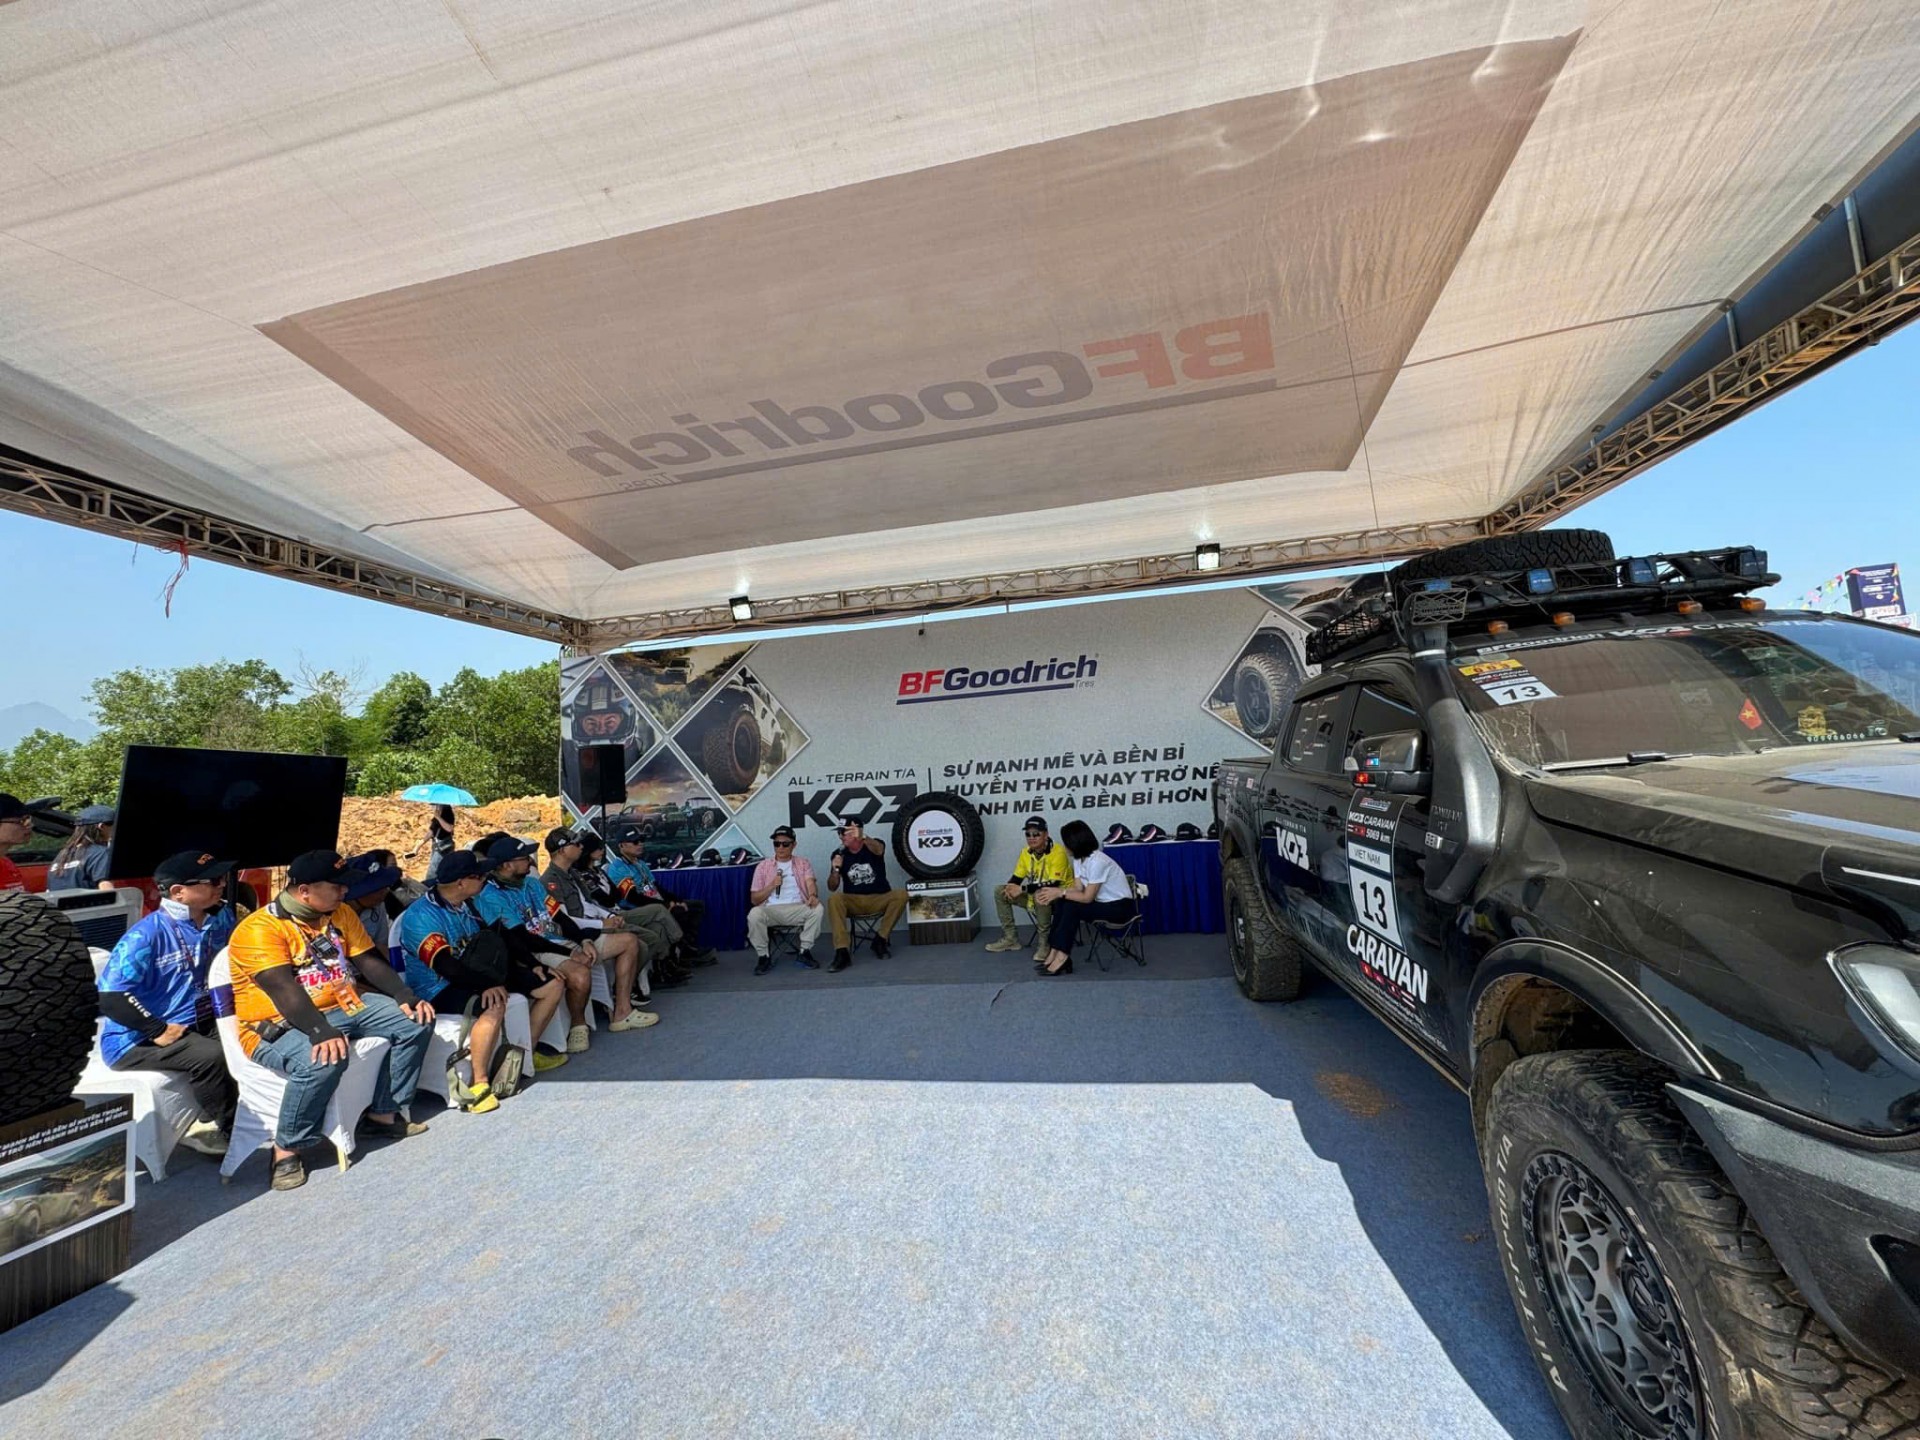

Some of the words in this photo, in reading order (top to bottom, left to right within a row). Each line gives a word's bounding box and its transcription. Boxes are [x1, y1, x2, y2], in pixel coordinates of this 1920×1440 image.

[898, 654, 1098, 696] BFGoodrich
[1502, 685, 1541, 701] 13
[788, 776, 814, 787] ALL
[826, 770, 890, 784] TERRAIN
[893, 768, 916, 779] T/A
[943, 758, 974, 780] SỰ
[975, 757, 1039, 777] MẠNH
[1043, 751, 1075, 770] MẼ
[1080, 747, 1108, 767] VÀ
[1112, 743, 1158, 765] BỀN
[1162, 742, 1185, 761] BỈ
[1022, 774, 1088, 793] THOẠI
[1093, 771, 1137, 787] NAY
[1140, 764, 1189, 783] TRỞ
[1191, 762, 1220, 781] NÊ
[1012, 795, 1045, 814] MẼ
[1049, 794, 1077, 811] VÀ
[1081, 788, 1127, 809] BỀN
[1131, 787, 1154, 806] BỈ
[1158, 786, 1208, 804] HƠN
[1364, 815, 1396, 831] CARAVAN
[918, 836, 954, 849] KO3
[1275, 826, 1310, 870] KO3
[1359, 880, 1388, 930] 13
[1346, 923, 1429, 1004] CARAVAN
[1496, 1133, 1513, 1174] T/A
